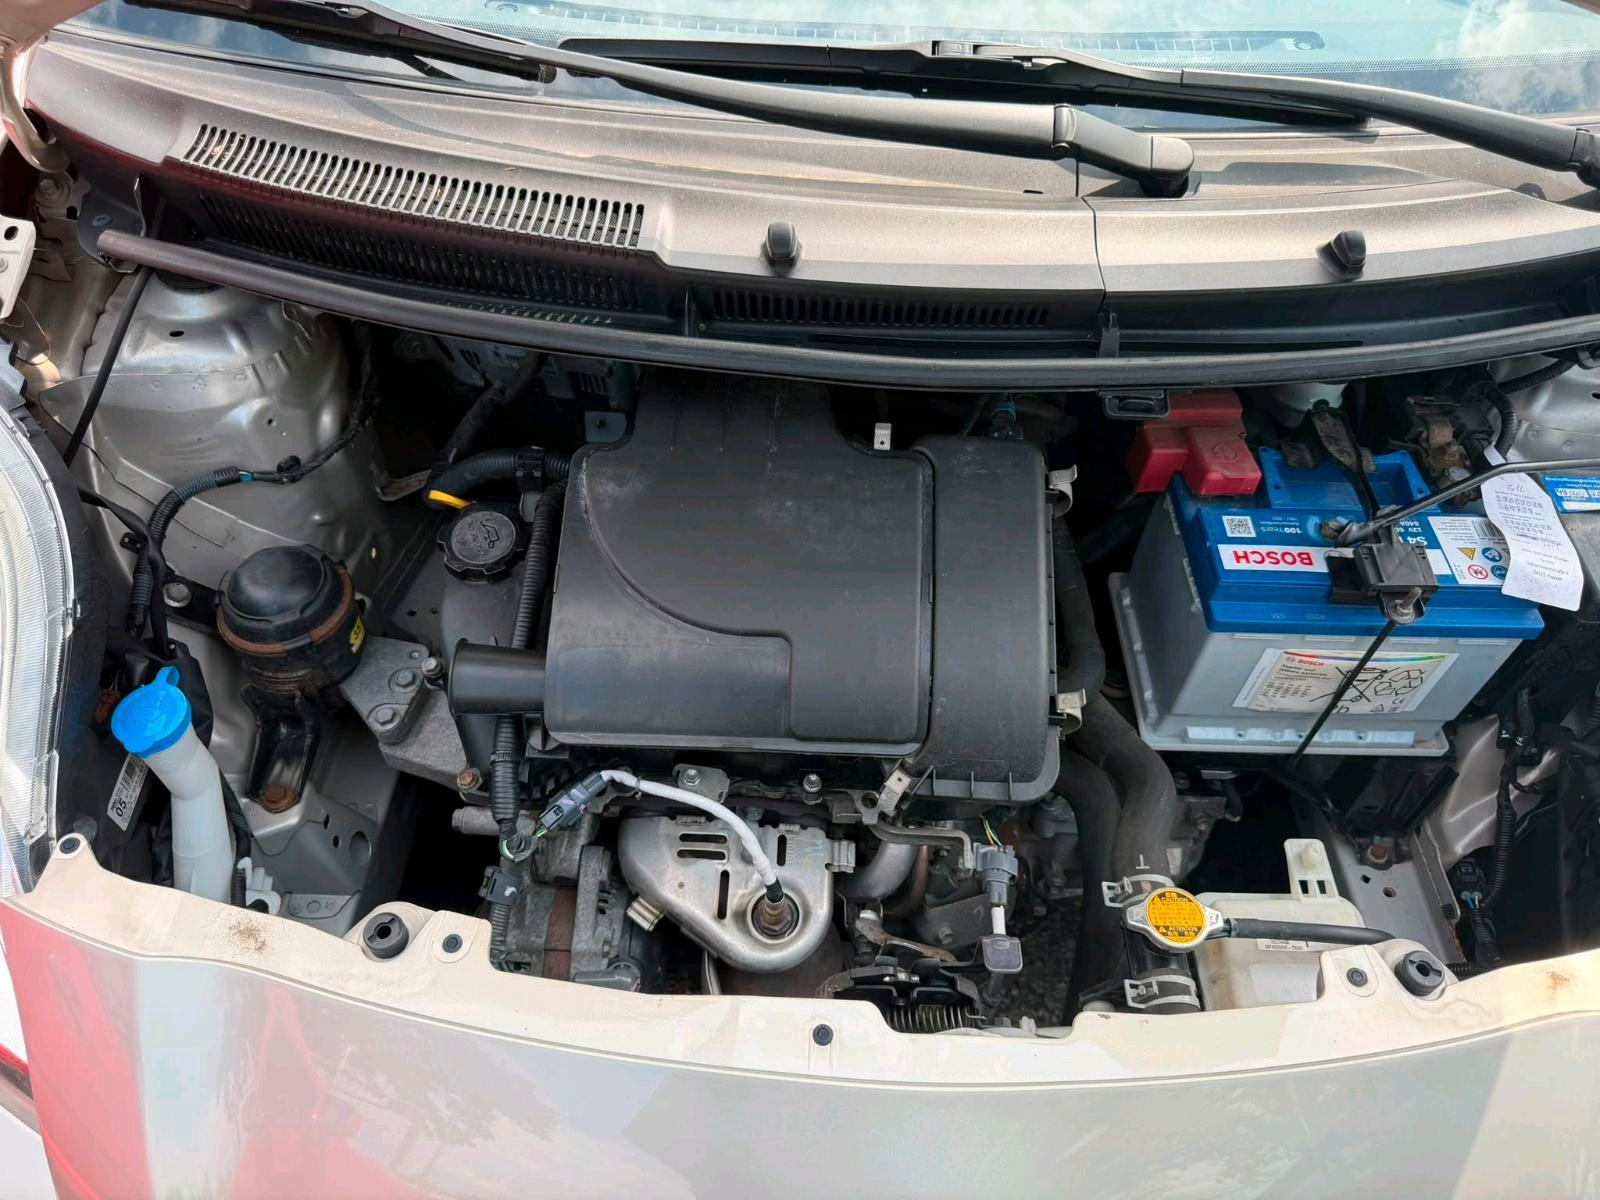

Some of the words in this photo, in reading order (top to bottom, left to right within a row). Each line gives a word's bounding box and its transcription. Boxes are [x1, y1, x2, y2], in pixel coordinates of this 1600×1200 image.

[1260, 525, 1283, 534] Years
[1284, 526, 1302, 534] 100
[1232, 550, 1314, 566] BOSCH
[1297, 658, 1325, 667] BOSCH
[116, 799, 128, 817] 05
